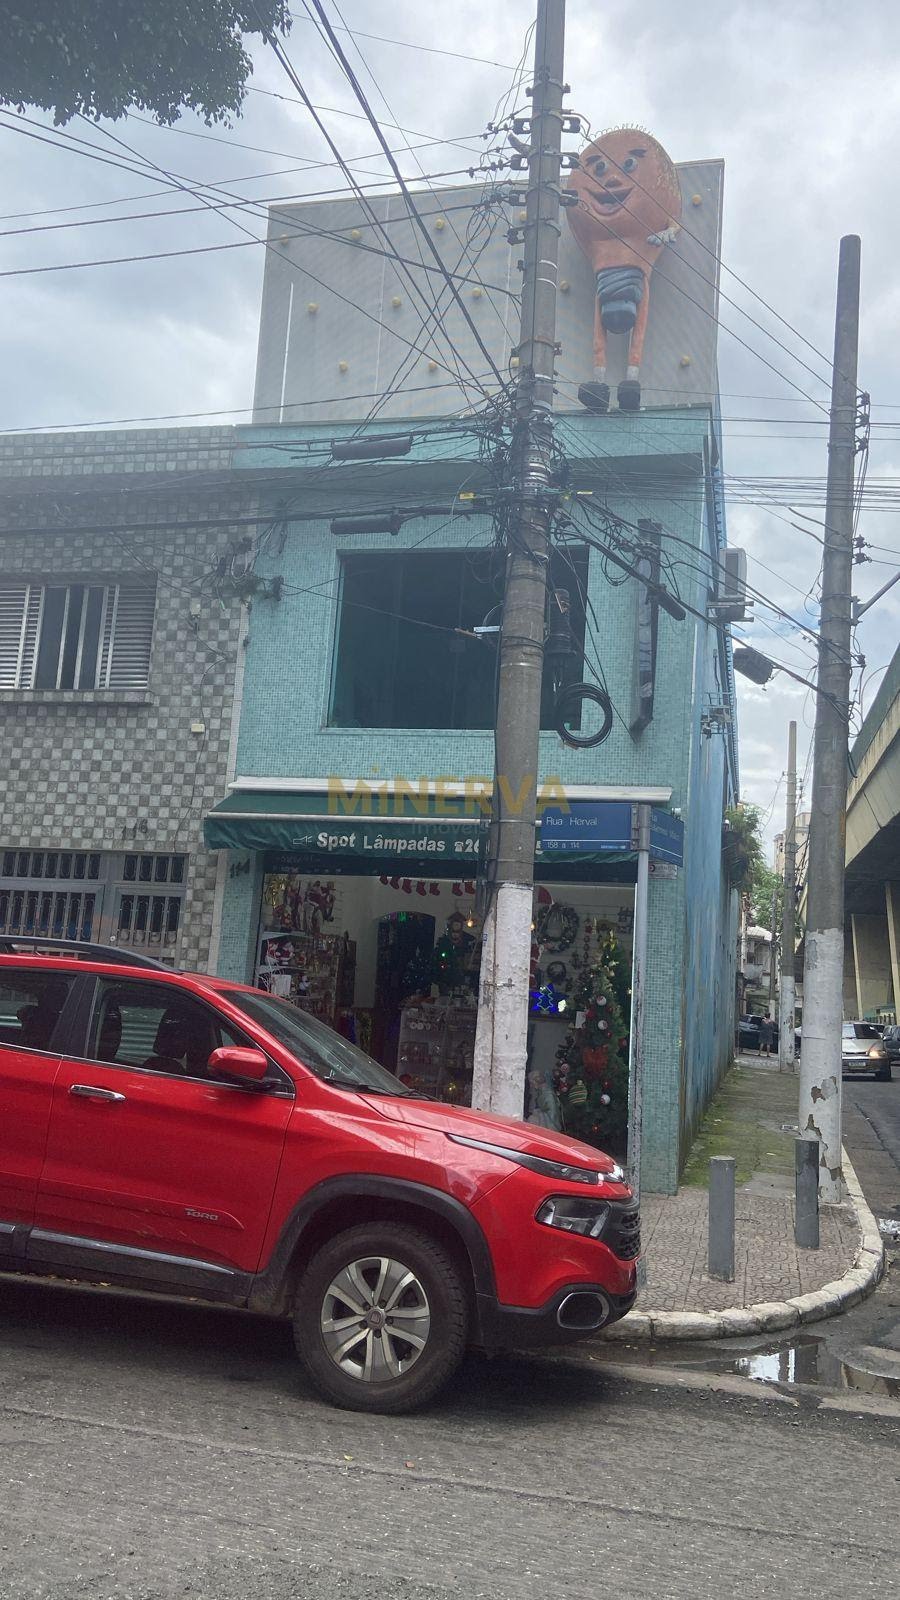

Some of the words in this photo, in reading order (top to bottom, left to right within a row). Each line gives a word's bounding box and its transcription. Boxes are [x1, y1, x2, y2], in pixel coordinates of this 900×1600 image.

[546, 816, 563, 826] Rua
[569, 816, 598, 826] Herval
[316, 831, 356, 852] Spot
[363, 834, 446, 854] Lâmpadas
